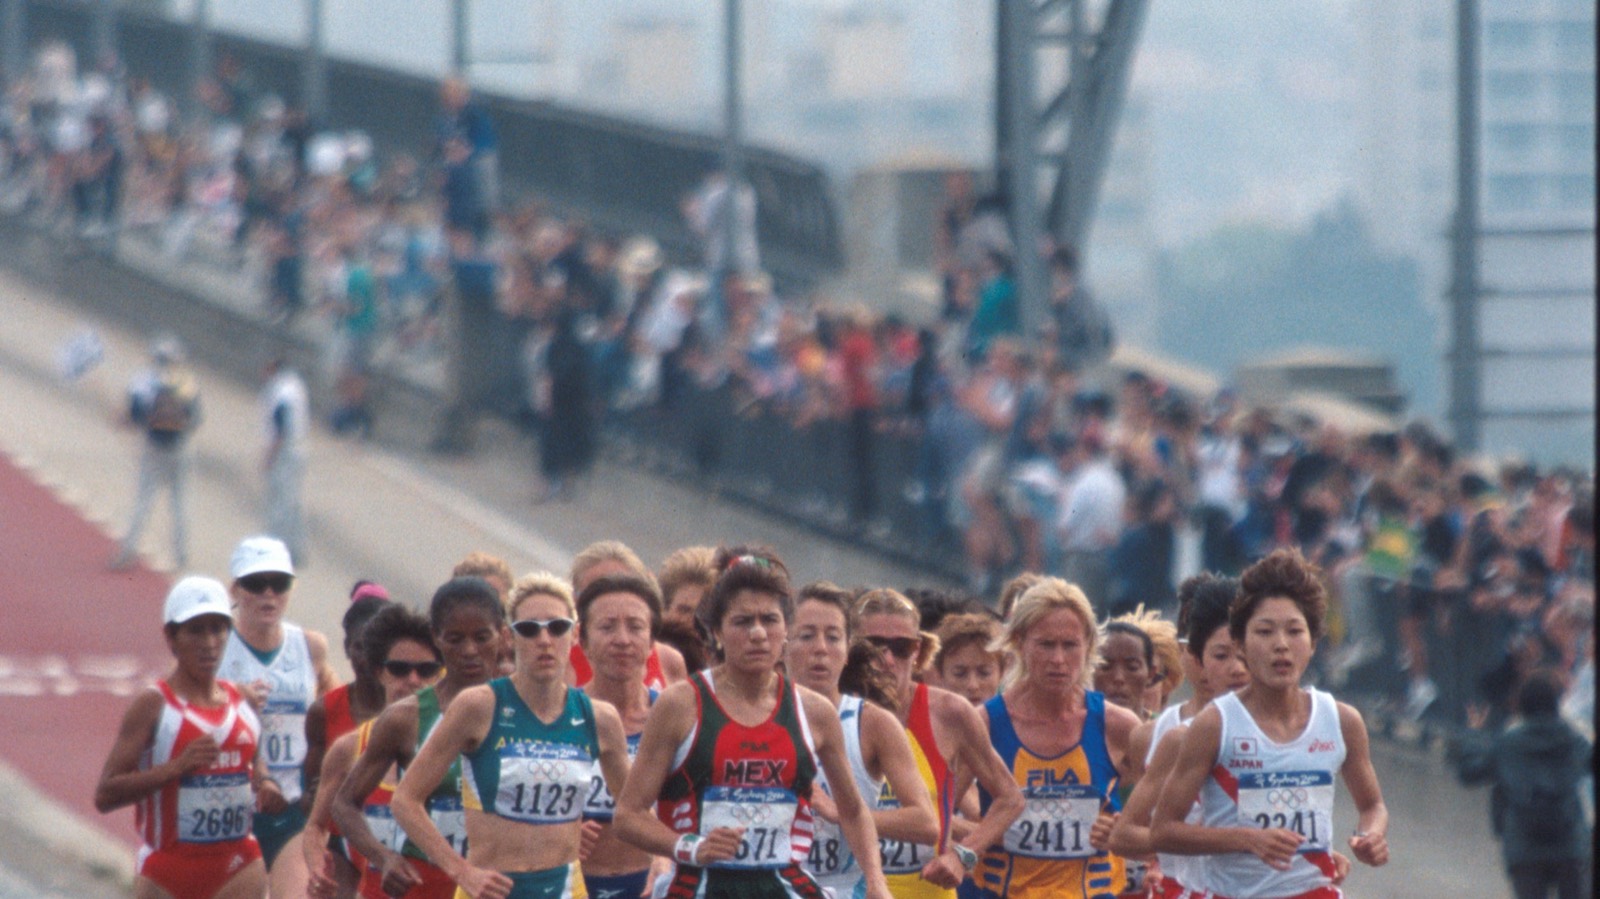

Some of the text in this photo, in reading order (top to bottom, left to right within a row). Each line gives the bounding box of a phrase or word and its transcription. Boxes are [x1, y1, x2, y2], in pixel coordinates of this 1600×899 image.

[724, 759, 788, 786] MEX
[1027, 767, 1080, 786] FILA
[1229, 760, 1263, 769] JAPAN
[511, 782, 577, 816] 1123
[192, 804, 244, 837] 2696
[1018, 820, 1083, 852] 2411
